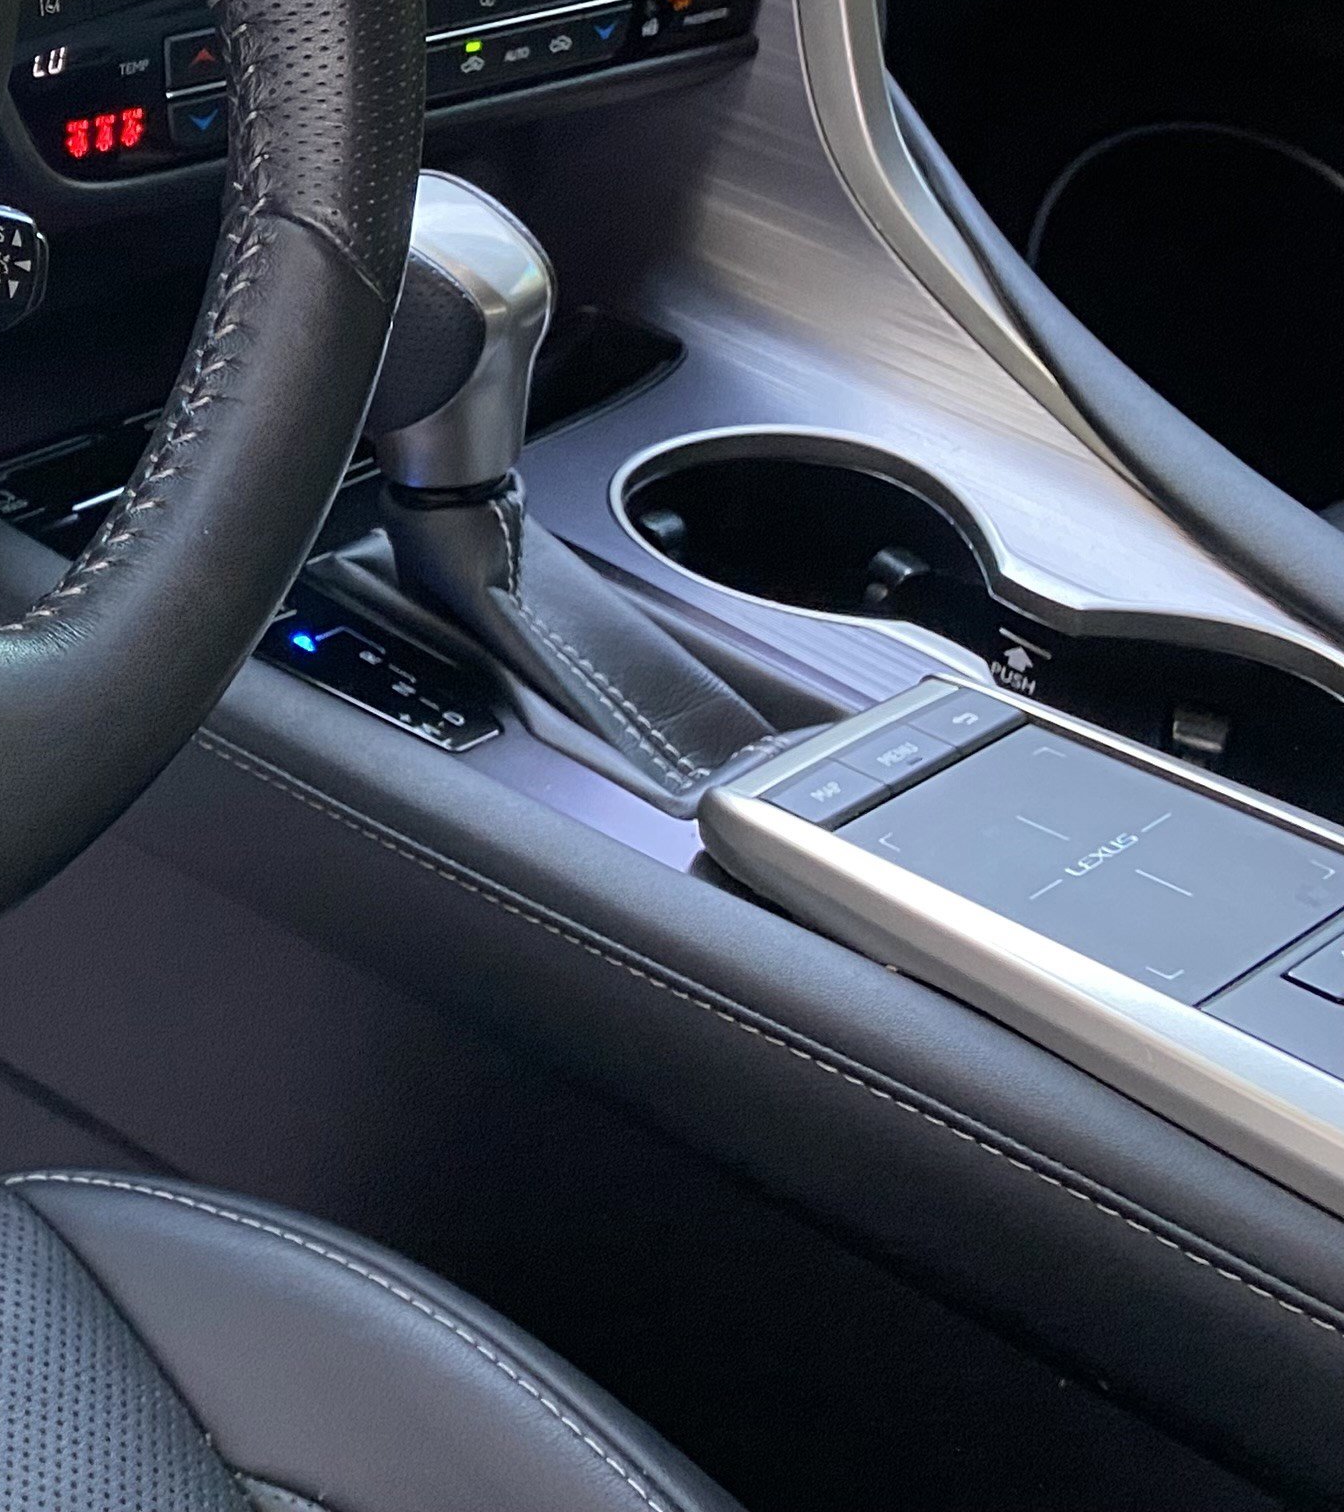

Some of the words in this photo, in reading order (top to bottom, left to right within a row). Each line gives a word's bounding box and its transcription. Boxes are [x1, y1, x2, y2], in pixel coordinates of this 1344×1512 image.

[119, 59, 150, 77] TEMP
[990, 660, 1037, 696] PUSH
[1064, 832, 1139, 877] LEXUS
